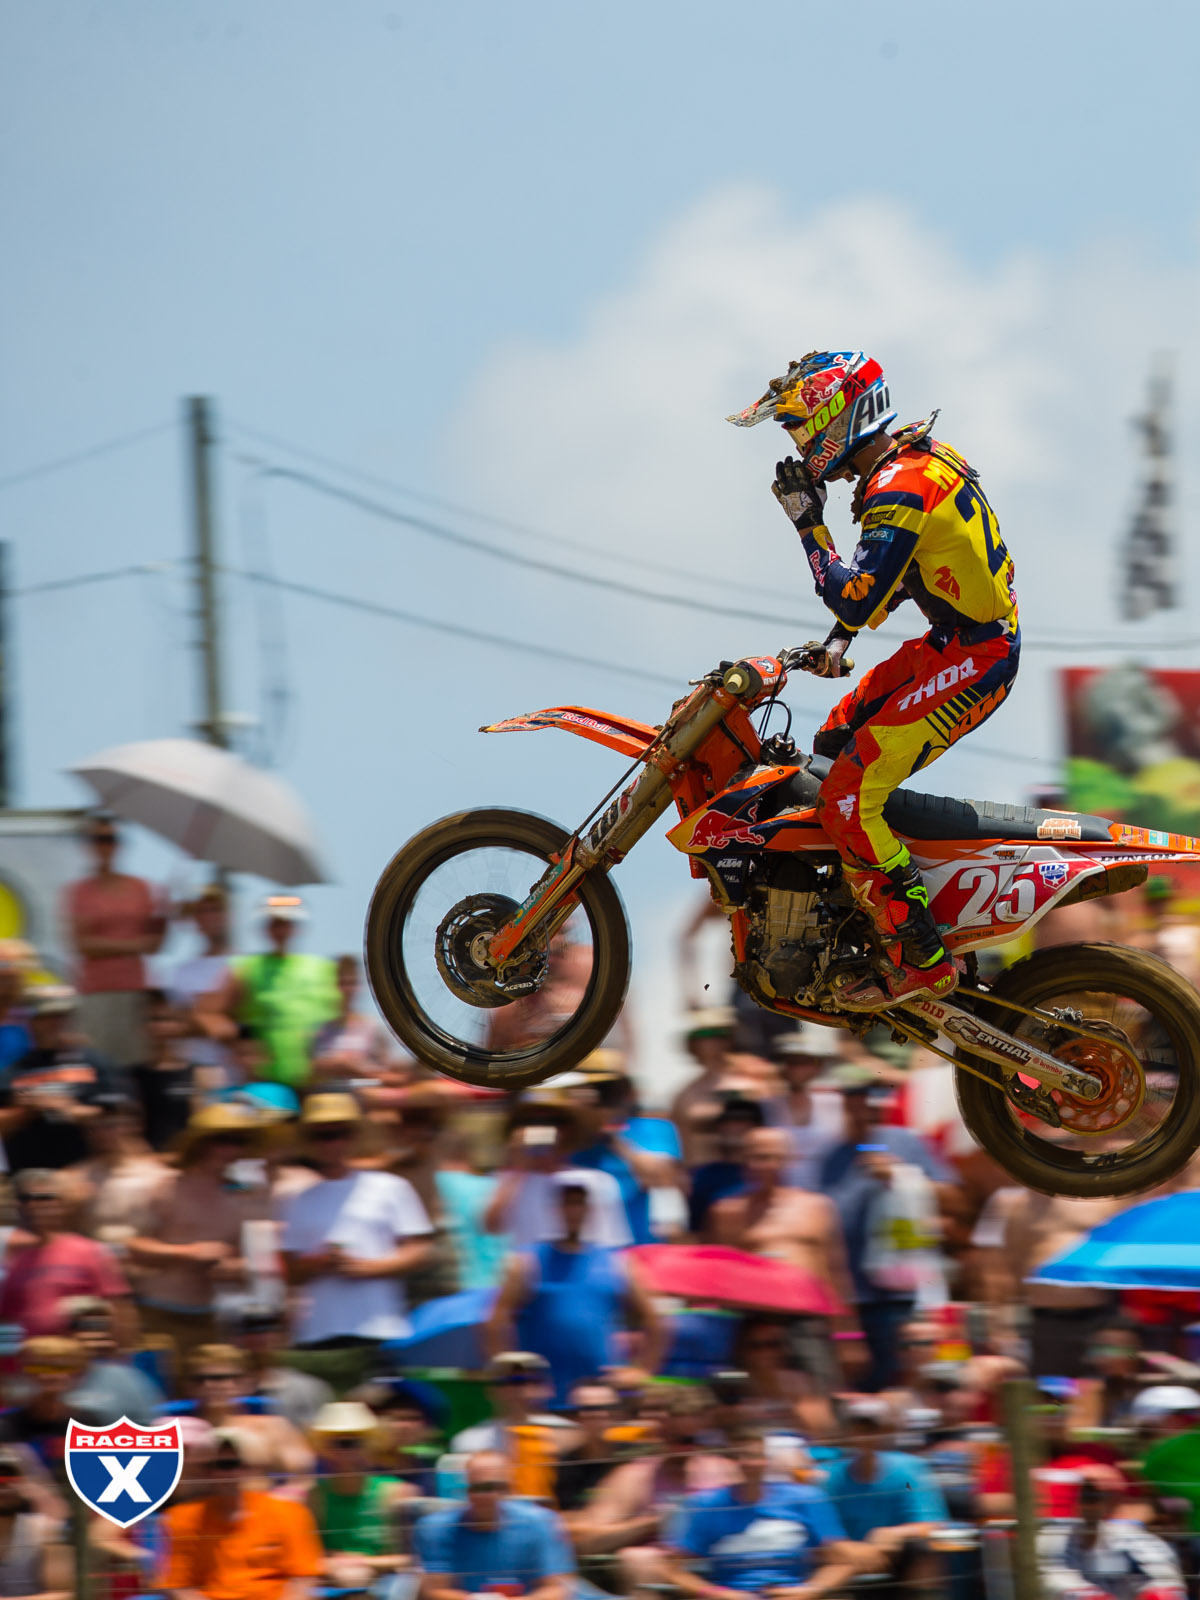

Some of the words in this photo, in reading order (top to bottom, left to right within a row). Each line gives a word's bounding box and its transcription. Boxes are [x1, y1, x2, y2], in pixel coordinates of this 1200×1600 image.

[804, 373, 866, 437] 100%
[810, 438, 841, 473] Bull
[897, 657, 979, 712] THOR
[562, 712, 588, 725] Red
[586, 717, 611, 732] Bull
[949, 682, 1006, 746] KTM
[716, 858, 743, 868] KTM
[1100, 853, 1176, 862] DUNLOP
[957, 864, 1036, 927] 25
[503, 982, 534, 992] ACERBIS
[1039, 1060, 1063, 1075] brembo
